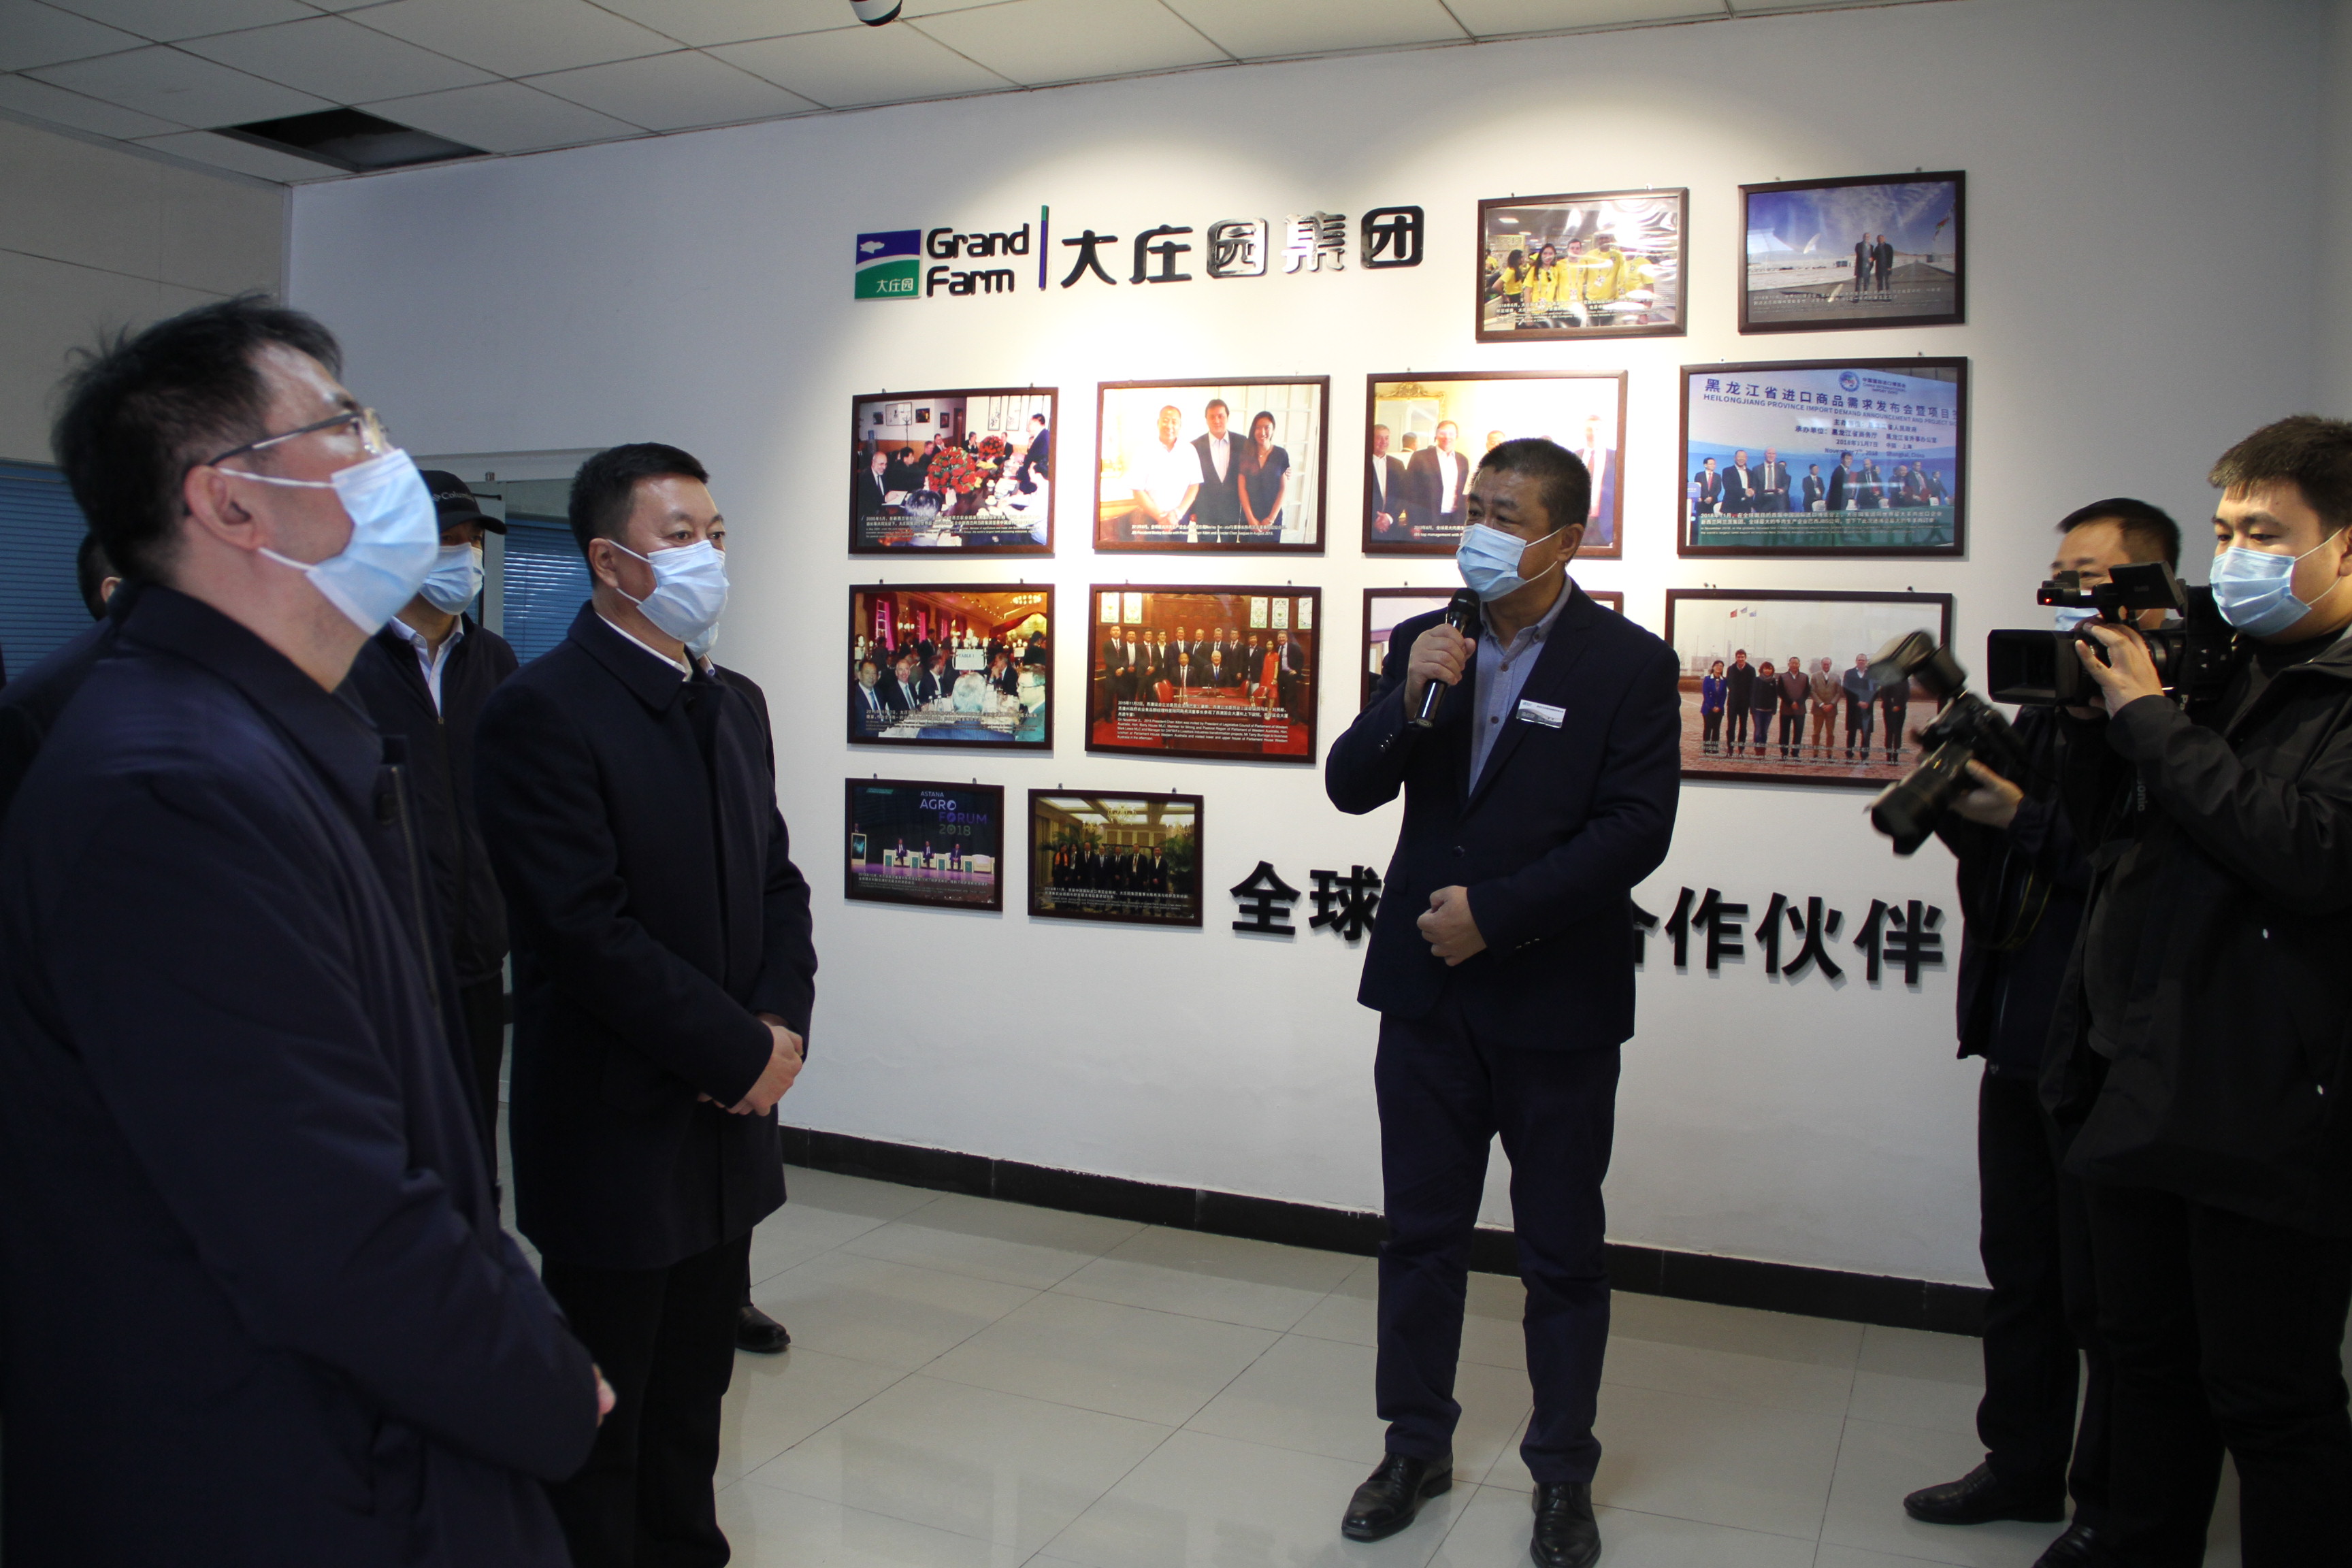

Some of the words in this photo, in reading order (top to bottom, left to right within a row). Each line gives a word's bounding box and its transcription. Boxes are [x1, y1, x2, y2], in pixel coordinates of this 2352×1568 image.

[926, 222, 1030, 259] Grand
[1060, 205, 1424, 289] 大庄园集团
[875, 278, 915, 293] 大庄园
[926, 265, 1015, 297] Farm
[1704, 394, 1765, 407] HEILONGJIANG
[1767, 401, 1805, 411] PROVINCE
[1806, 405, 1833, 414] IMPORT
[1834, 409, 1862, 417] DEMAND
[920, 799, 957, 811] AGRO
[938, 812, 987, 824] FORUM
[939, 824, 971, 836] 2018
